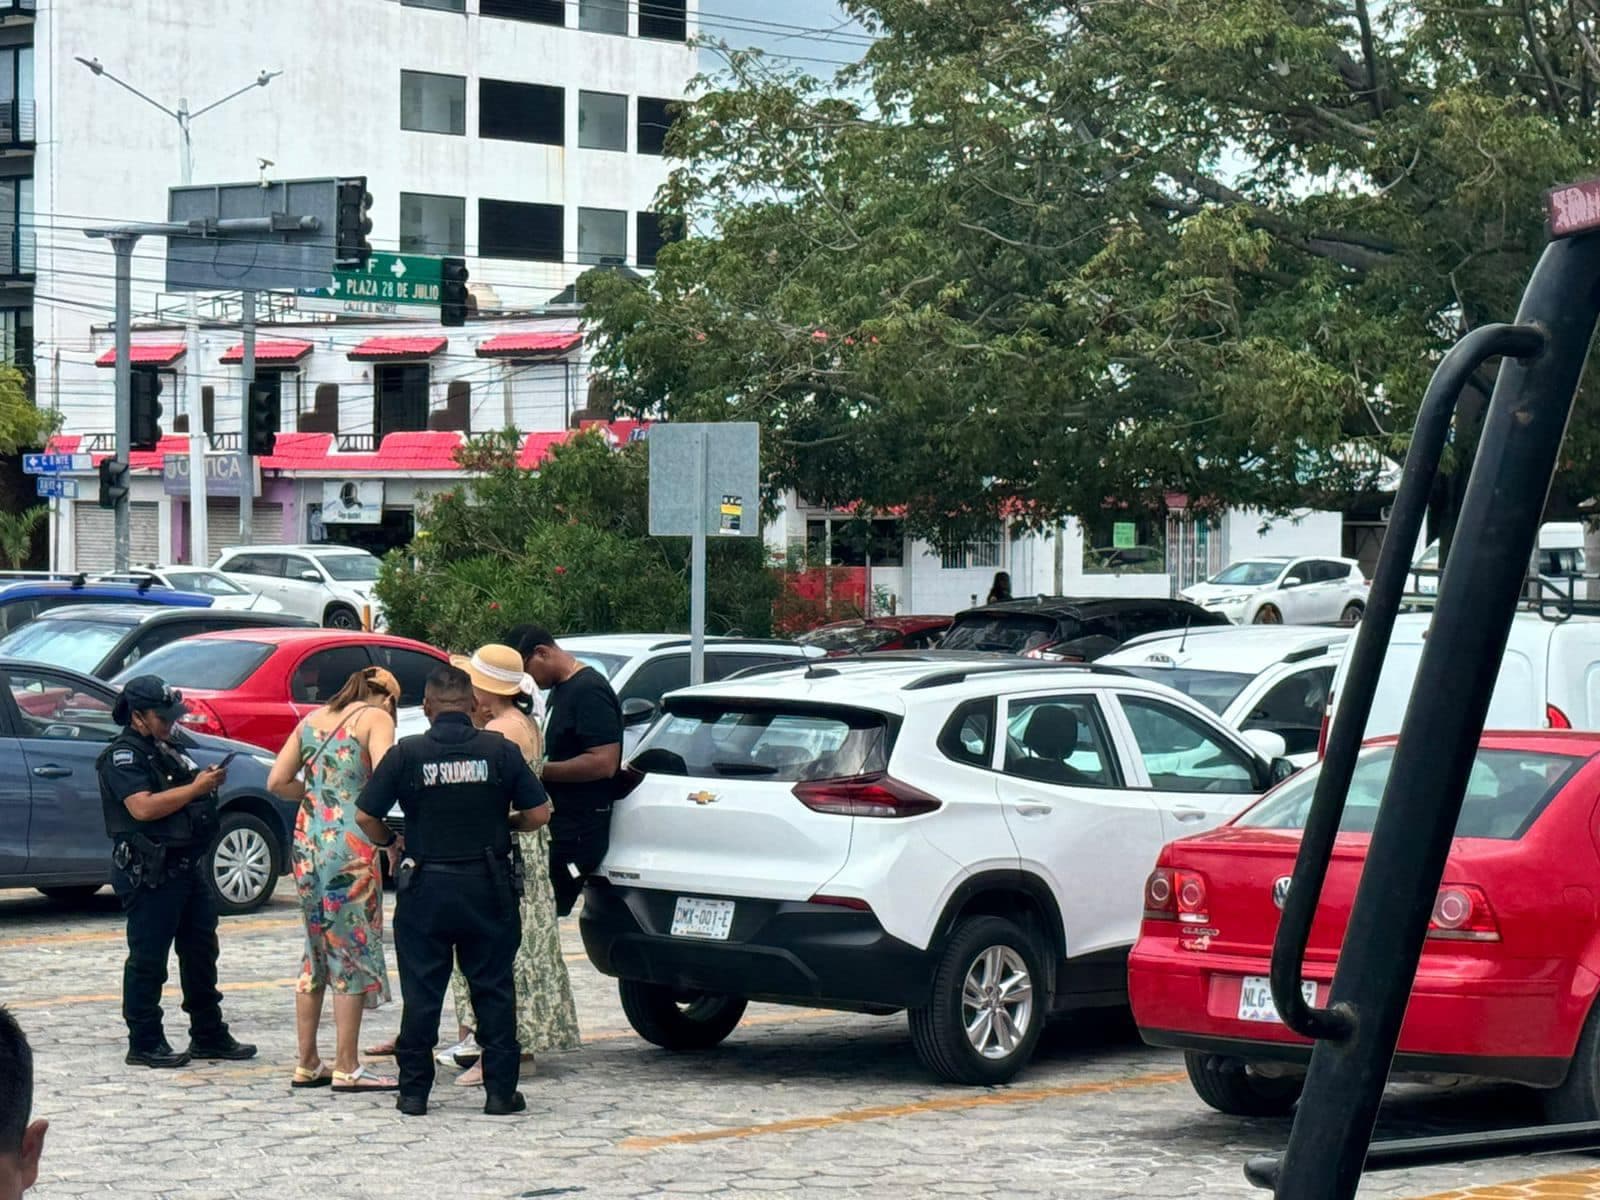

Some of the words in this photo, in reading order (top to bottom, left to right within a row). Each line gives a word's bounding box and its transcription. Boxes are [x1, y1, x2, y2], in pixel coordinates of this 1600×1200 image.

[346, 279, 378, 296] PLAZA
[382, 281, 394, 297] 28
[397, 282, 409, 299] DE
[412, 283, 439, 300] JULIO
[177, 456, 242, 478] OTICA
[1149, 655, 1170, 663] TAXI
[422, 763, 438, 786] SSP
